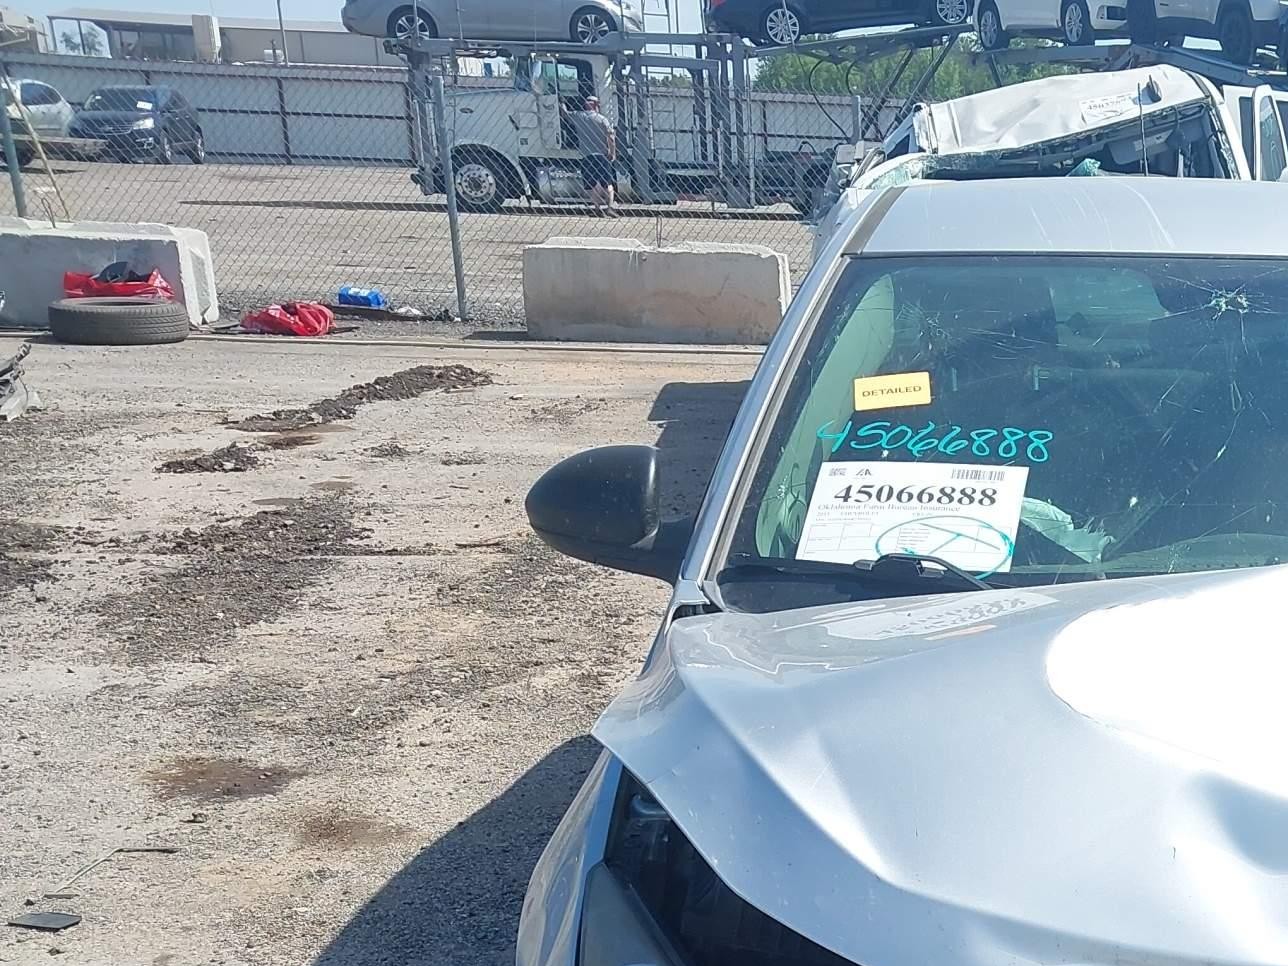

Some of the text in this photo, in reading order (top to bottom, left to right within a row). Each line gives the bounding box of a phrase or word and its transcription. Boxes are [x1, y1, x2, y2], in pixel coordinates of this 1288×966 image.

[862, 385, 922, 397] DETAILED
[816, 420, 1053, 463] 45066888
[834, 483, 998, 507] 45066888
